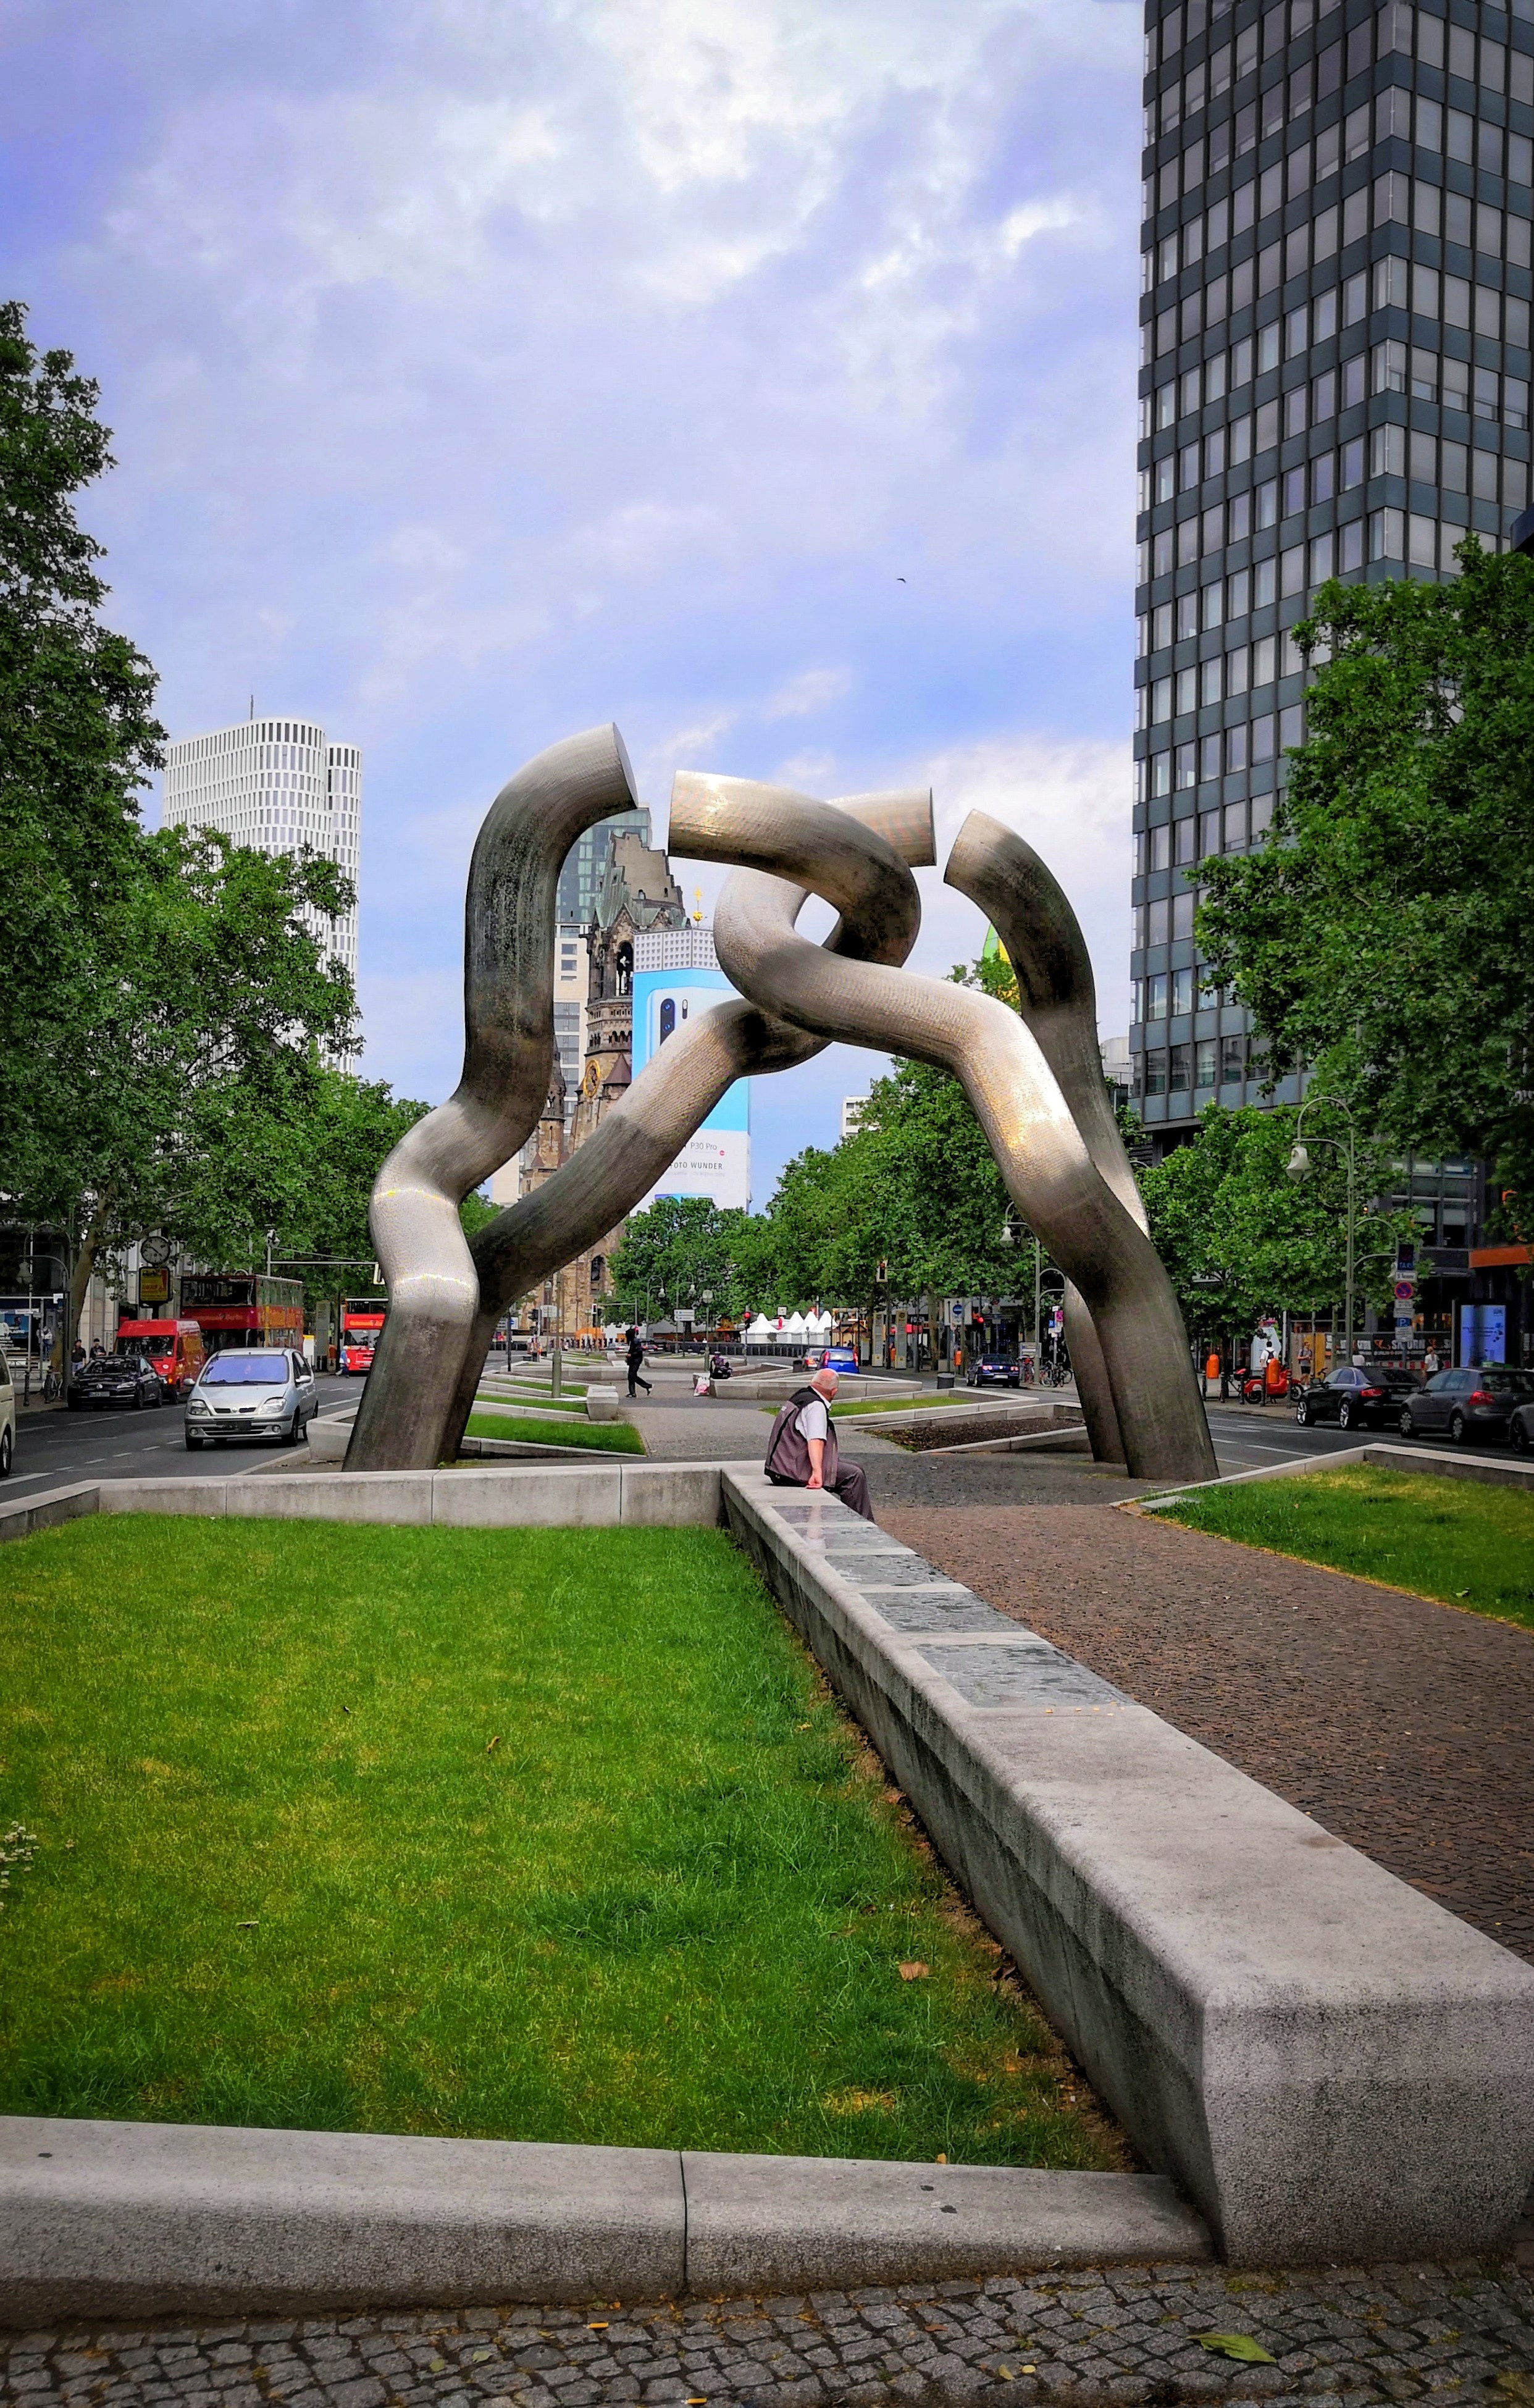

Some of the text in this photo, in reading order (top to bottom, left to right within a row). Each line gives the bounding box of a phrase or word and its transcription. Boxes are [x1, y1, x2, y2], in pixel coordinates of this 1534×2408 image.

[690, 1142, 704, 1150] P30
[691, 1162, 723, 1170] WUNDER
[1391, 1339, 1426, 1349] SAURN
